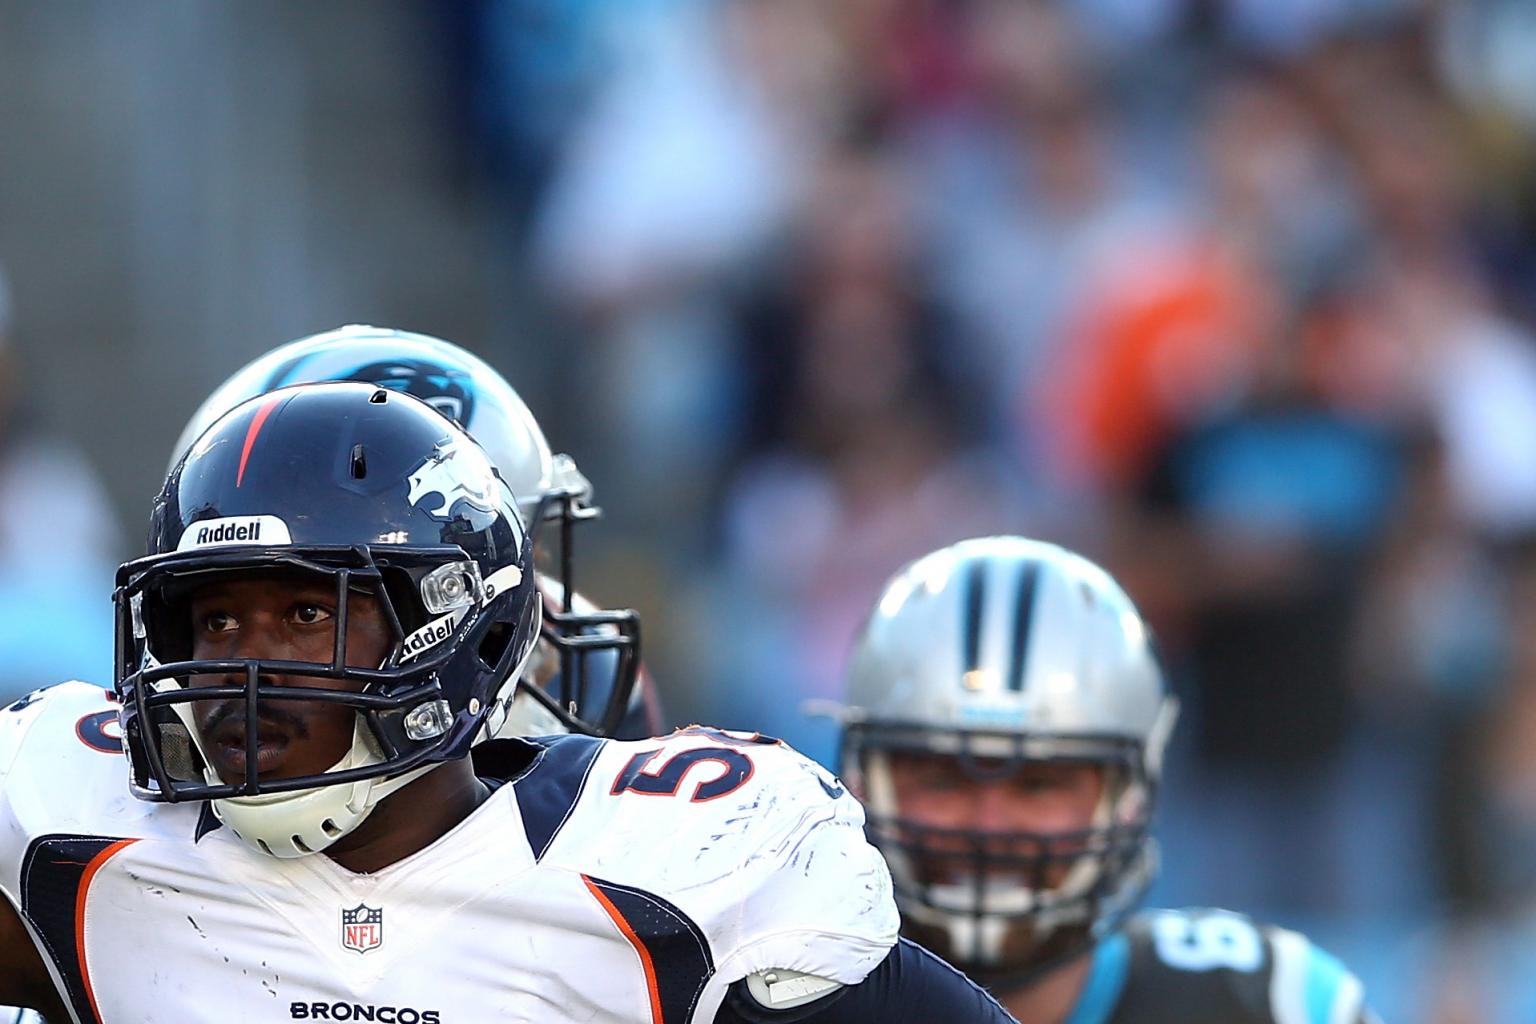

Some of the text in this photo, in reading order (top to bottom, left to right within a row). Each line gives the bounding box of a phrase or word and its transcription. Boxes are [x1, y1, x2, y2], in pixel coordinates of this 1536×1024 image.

[196, 522, 261, 545] Riddell
[402, 616, 455, 656] iddell
[346, 924, 378, 949] NFL
